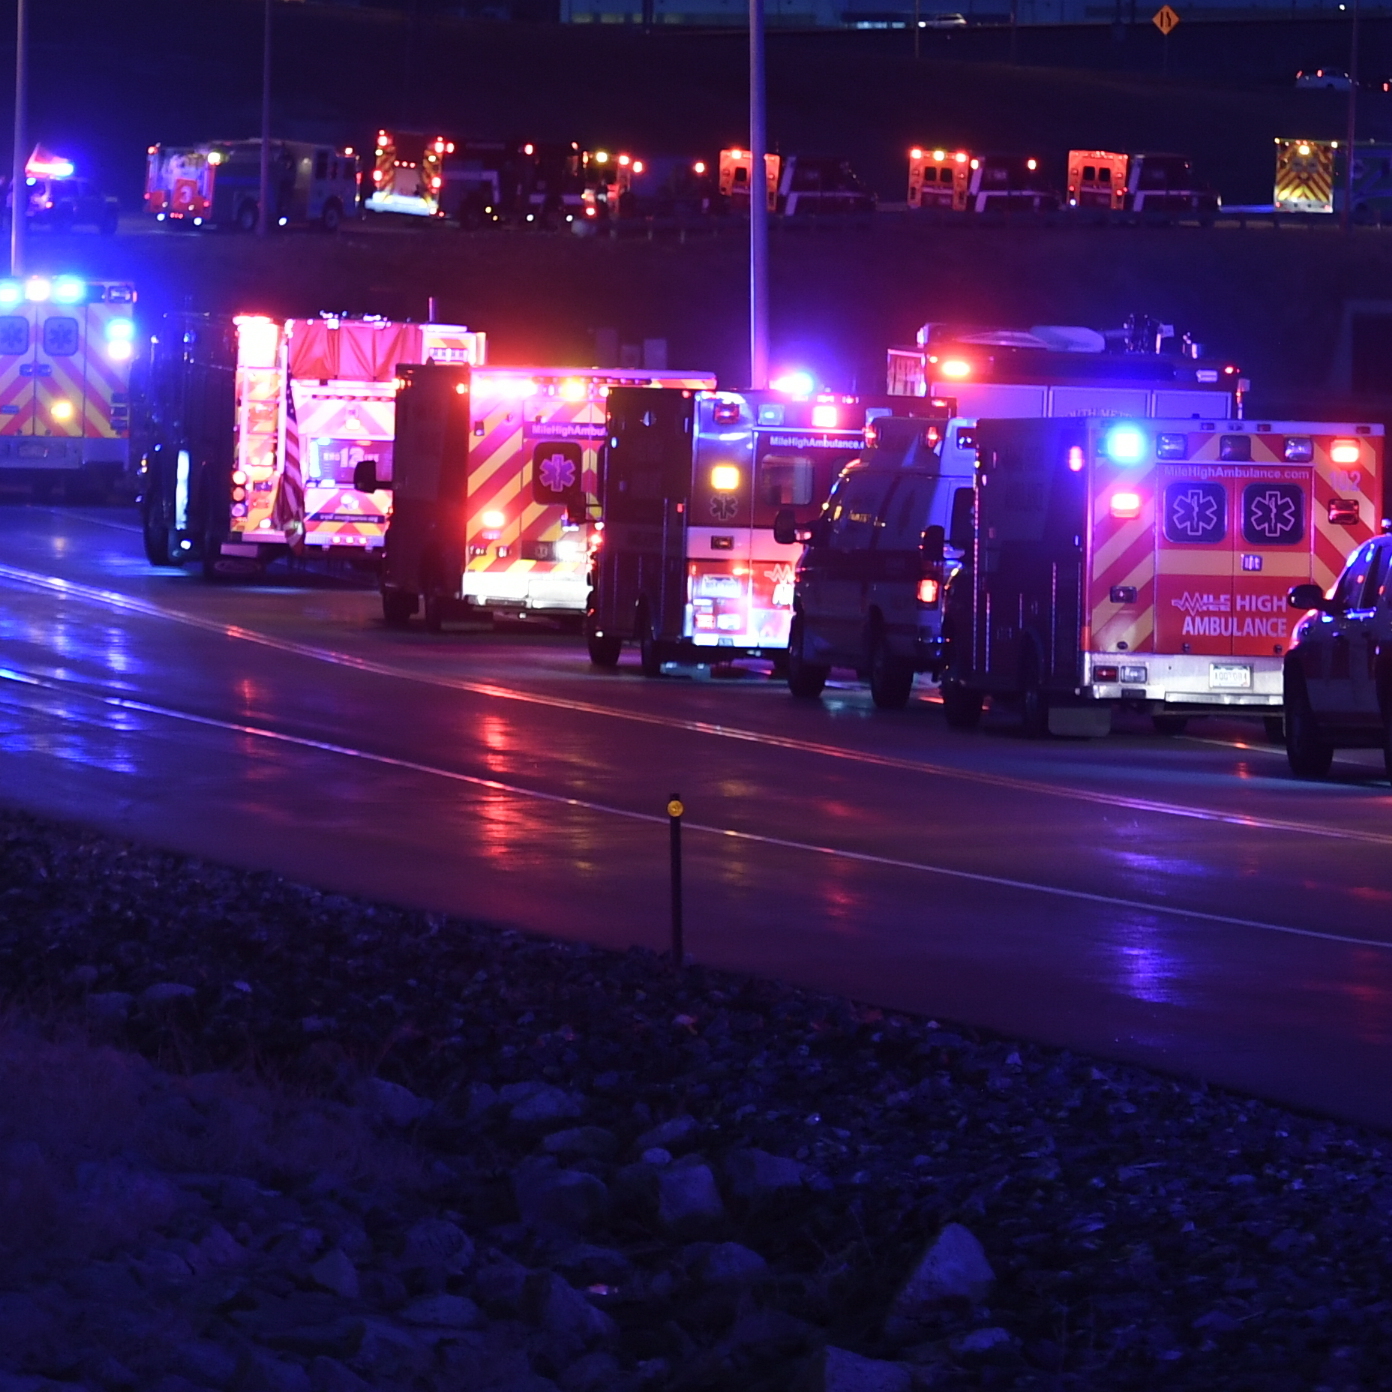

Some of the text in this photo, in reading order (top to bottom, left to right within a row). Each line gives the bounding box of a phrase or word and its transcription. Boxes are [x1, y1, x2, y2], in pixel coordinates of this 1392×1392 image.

[1164, 466, 1310, 479] MileHighAmbulance.com
[1236, 594, 1287, 612] HIGH
[1182, 615, 1287, 637] AMBULANCE
